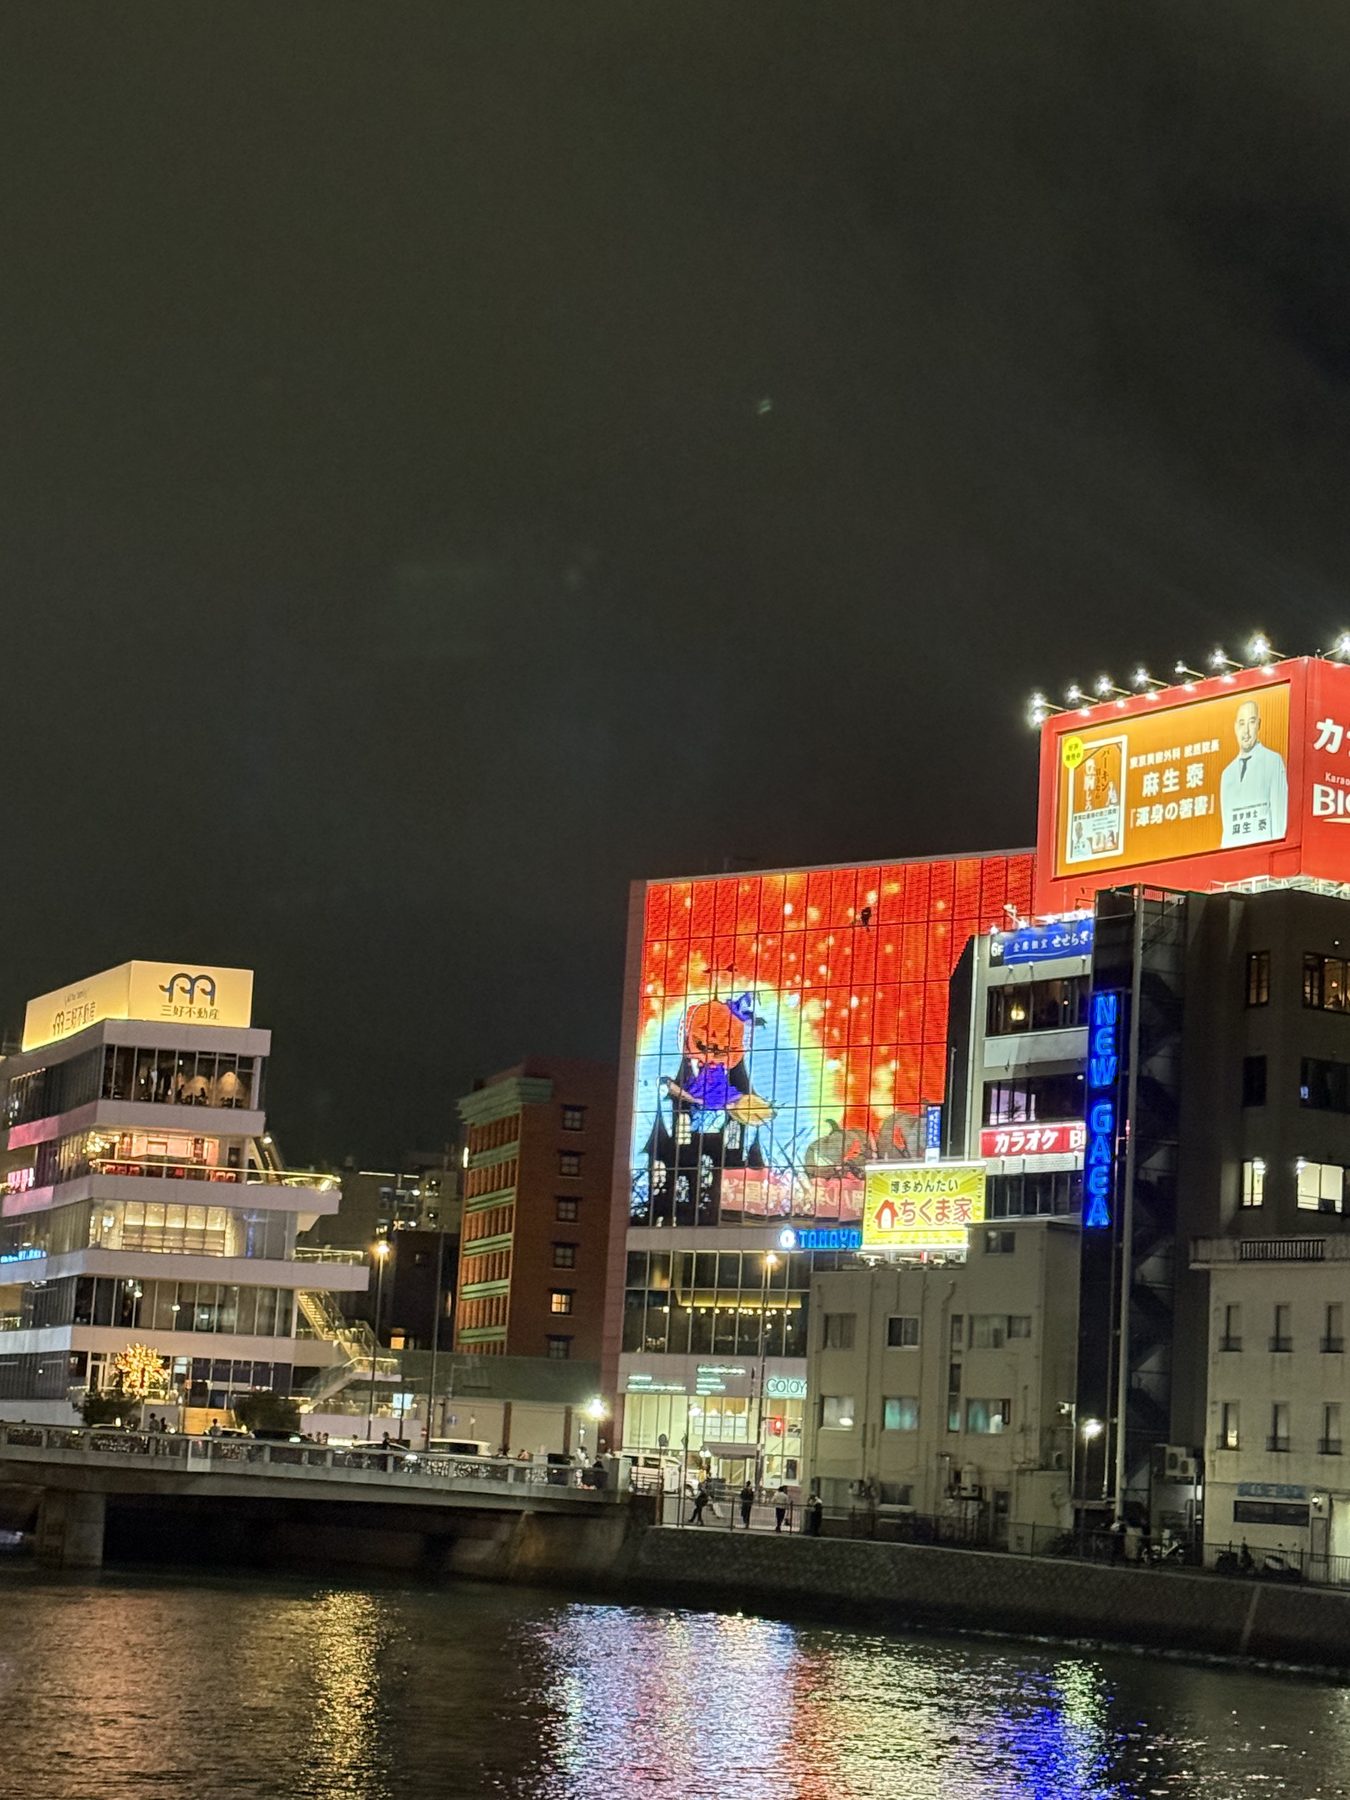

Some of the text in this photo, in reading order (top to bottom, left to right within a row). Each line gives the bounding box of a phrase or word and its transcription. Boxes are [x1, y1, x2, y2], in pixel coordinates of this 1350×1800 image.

[1313, 718, 1350, 754] カ
[160, 1004, 219, 1020] 三好不動産
[1086, 994, 1118, 1227] NEW GAEA
[994, 1129, 1058, 1154] カラオケ
[890, 1179, 958, 1194] 博多めんたい
[900, 1198, 972, 1224] ちくま家
